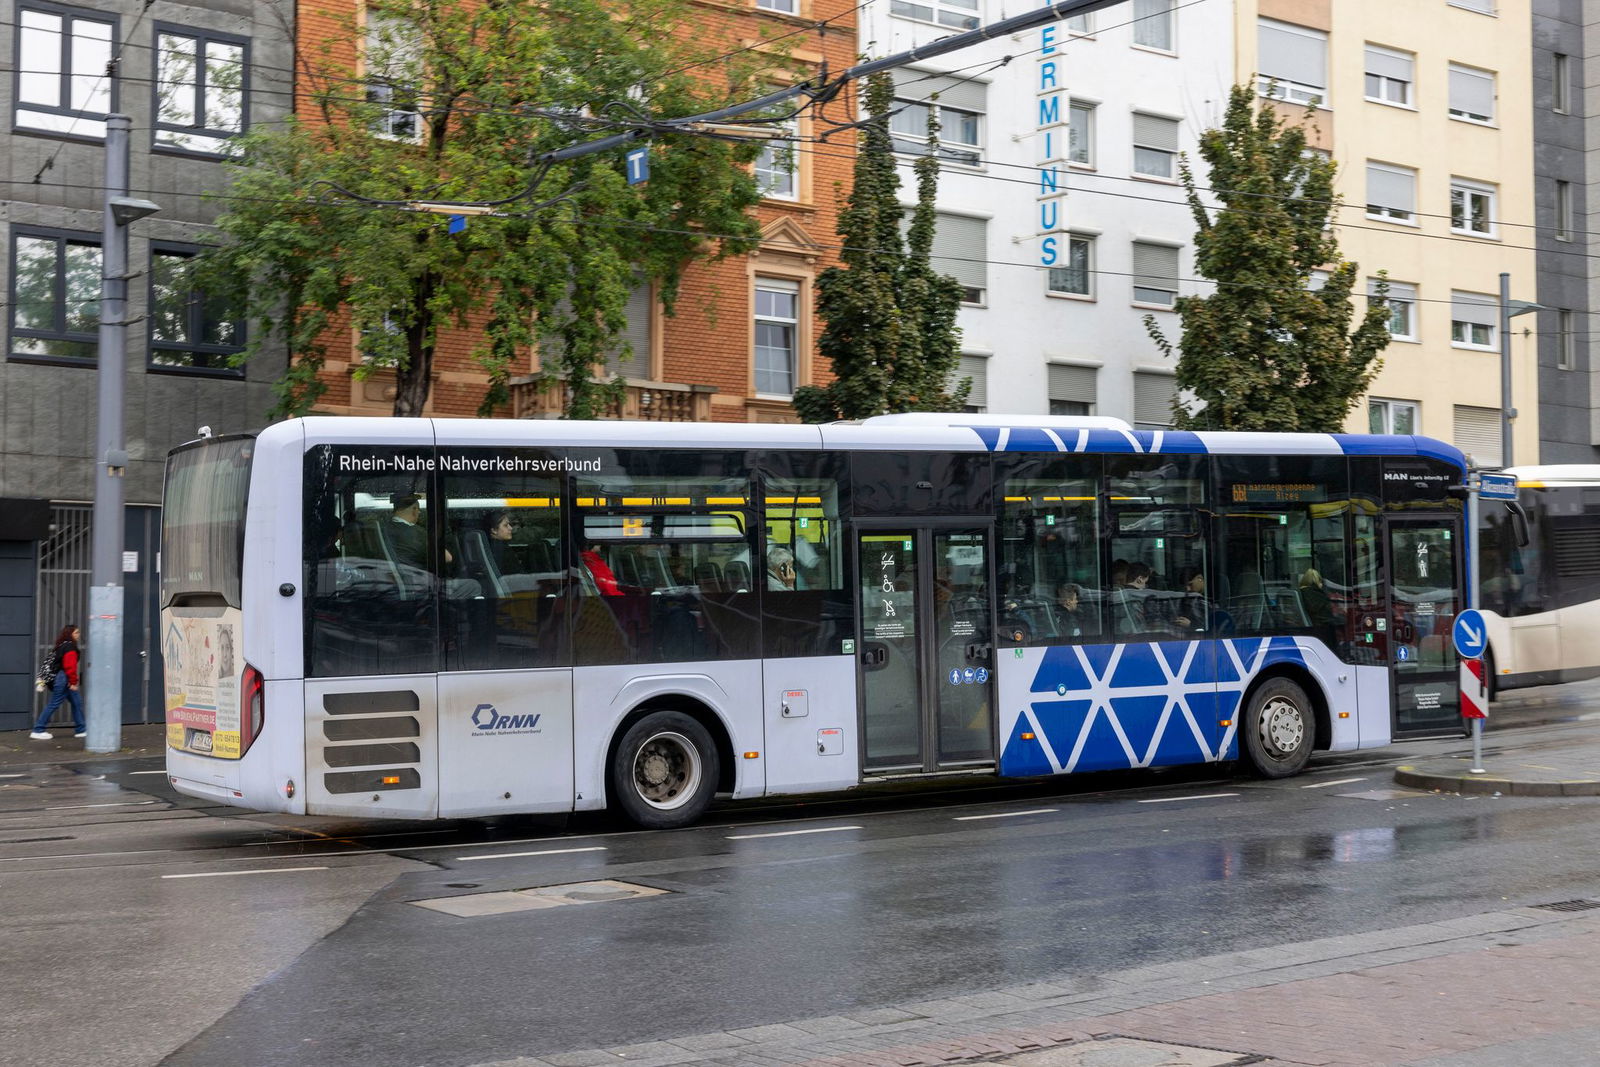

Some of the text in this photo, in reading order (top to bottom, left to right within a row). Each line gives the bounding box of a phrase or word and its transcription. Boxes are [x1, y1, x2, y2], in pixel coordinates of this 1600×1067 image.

[1040, 0, 1058, 265] ERMINUS
[628, 152, 645, 179] T
[339, 455, 601, 471] Rhein-Nahe Nahverkehrsverbund
